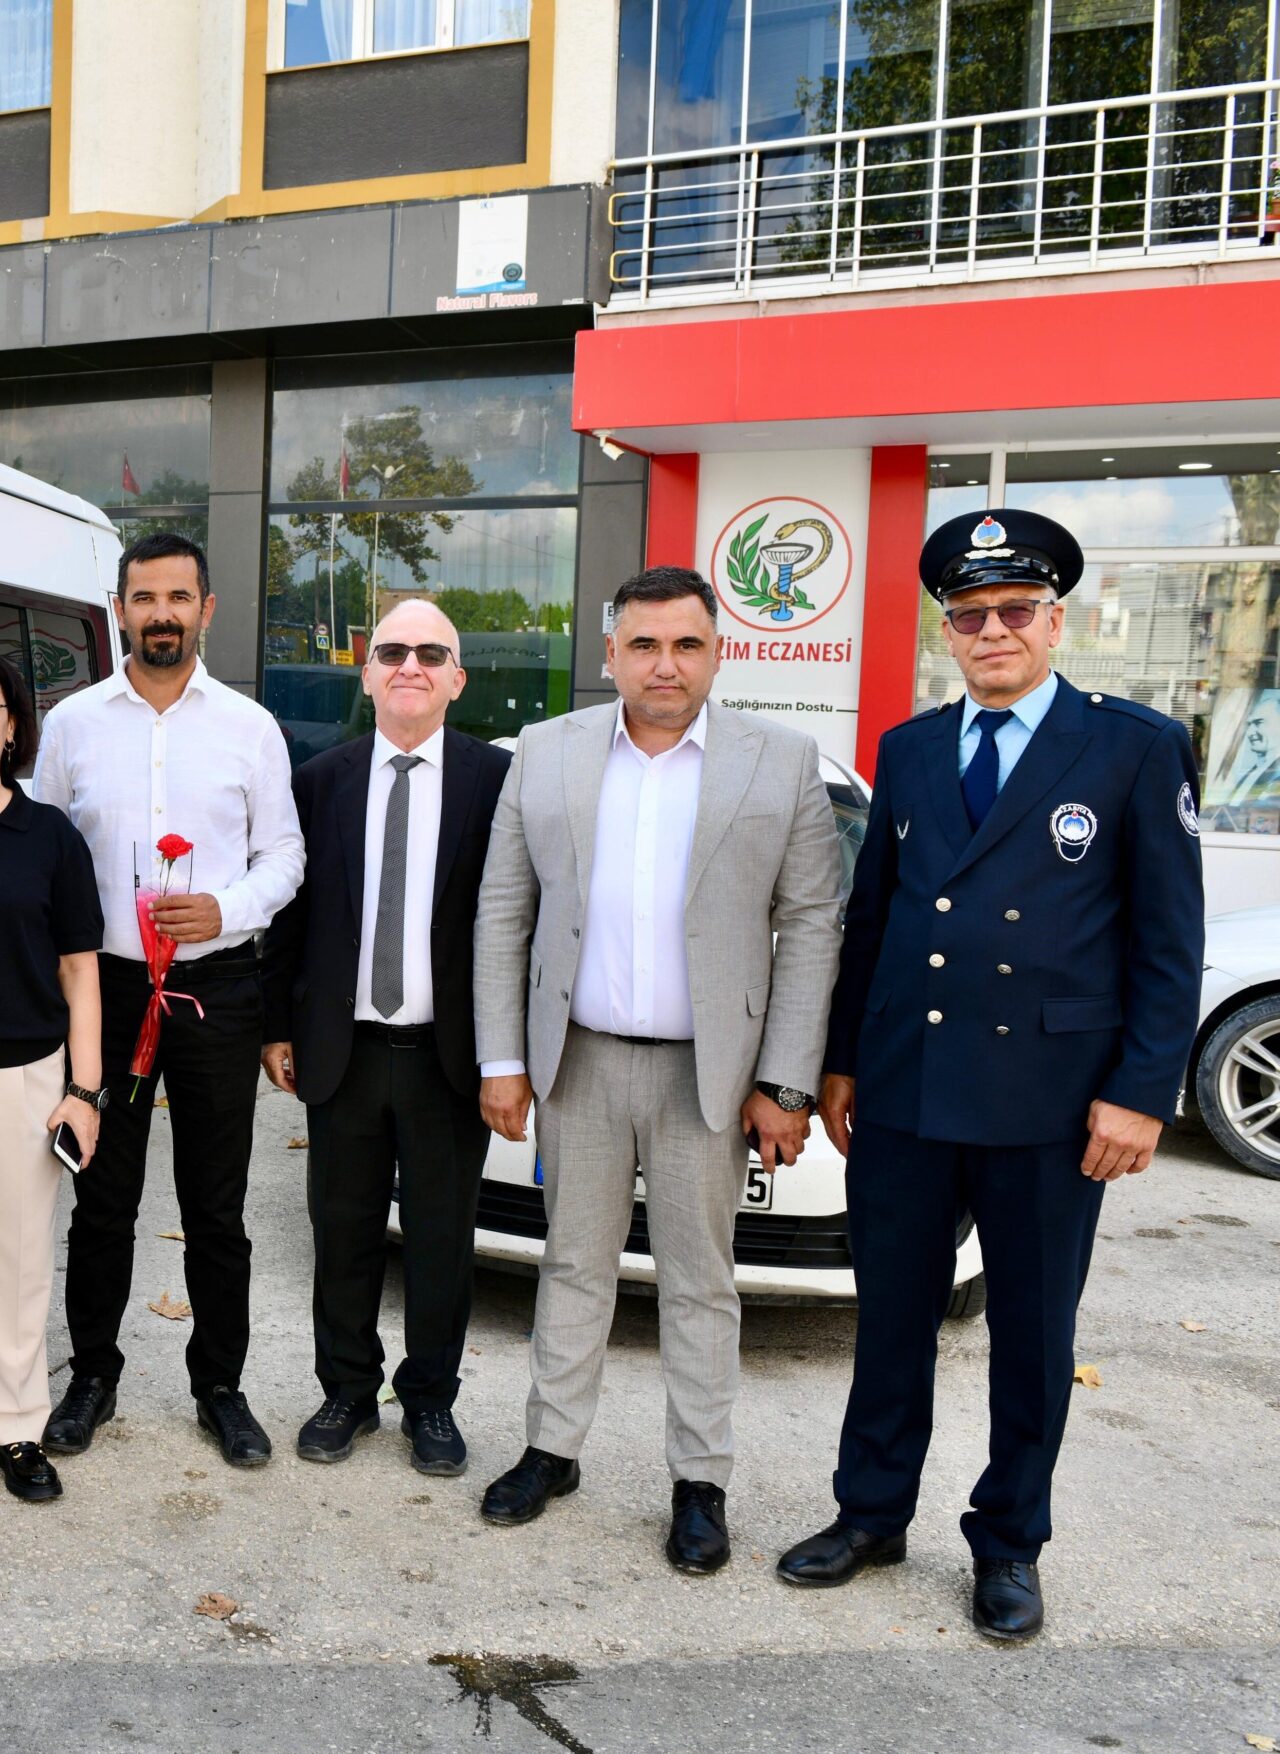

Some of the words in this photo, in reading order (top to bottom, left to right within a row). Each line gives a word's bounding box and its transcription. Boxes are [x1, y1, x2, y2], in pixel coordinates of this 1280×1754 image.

[436, 294, 486, 312] Natural
[489, 292, 538, 309] Flavors
[757, 637, 853, 663] ECZANESİ
[721, 698, 793, 711] Sağlığınızın
[796, 702, 834, 713] Dostu
